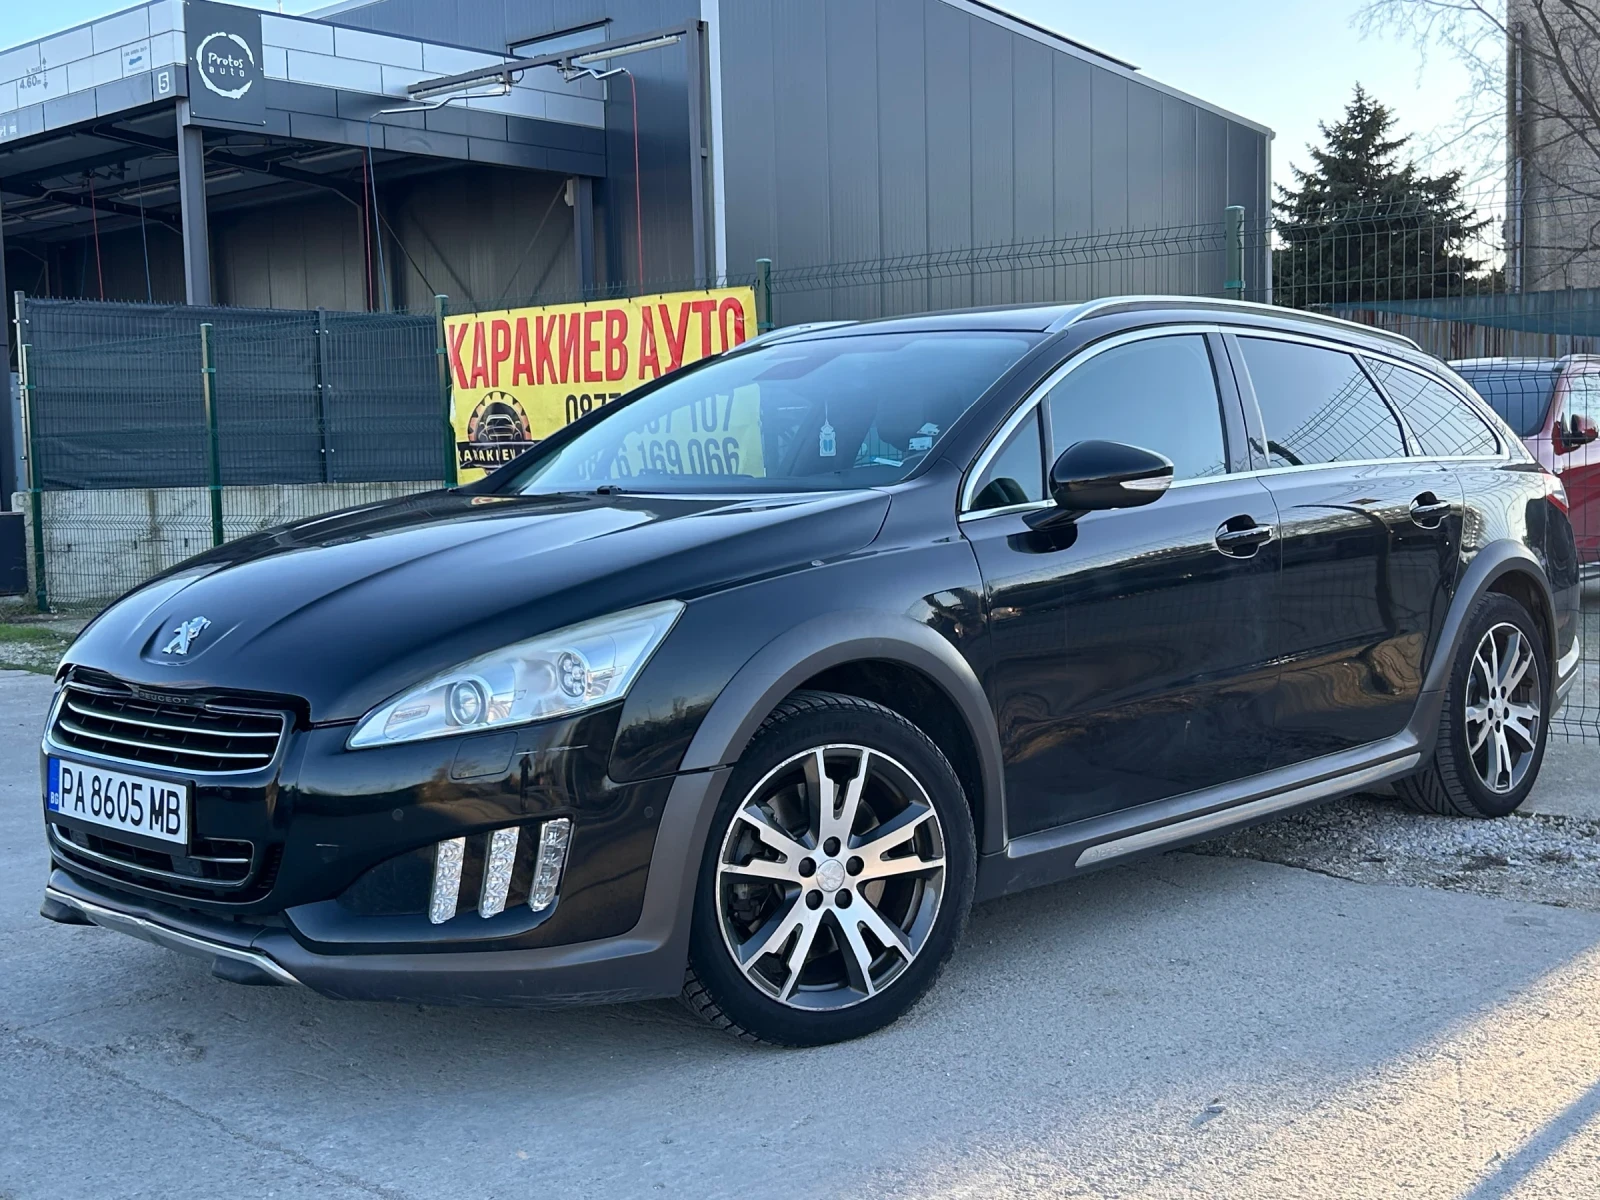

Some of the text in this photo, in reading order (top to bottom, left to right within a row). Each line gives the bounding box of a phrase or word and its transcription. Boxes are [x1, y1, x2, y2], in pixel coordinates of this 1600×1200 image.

[208, 52, 244, 69] Protos
[209, 66, 245, 77] auto
[160, 75, 168, 91] 5
[449, 297, 746, 389] КАРАКИЕВ АУТО
[638, 440, 684, 476] 169
[688, 437, 739, 475] 066
[139, 691, 190, 704] PEUGEOT
[50, 791, 59, 804] BG
[61, 767, 181, 835] PA 8605 MB
